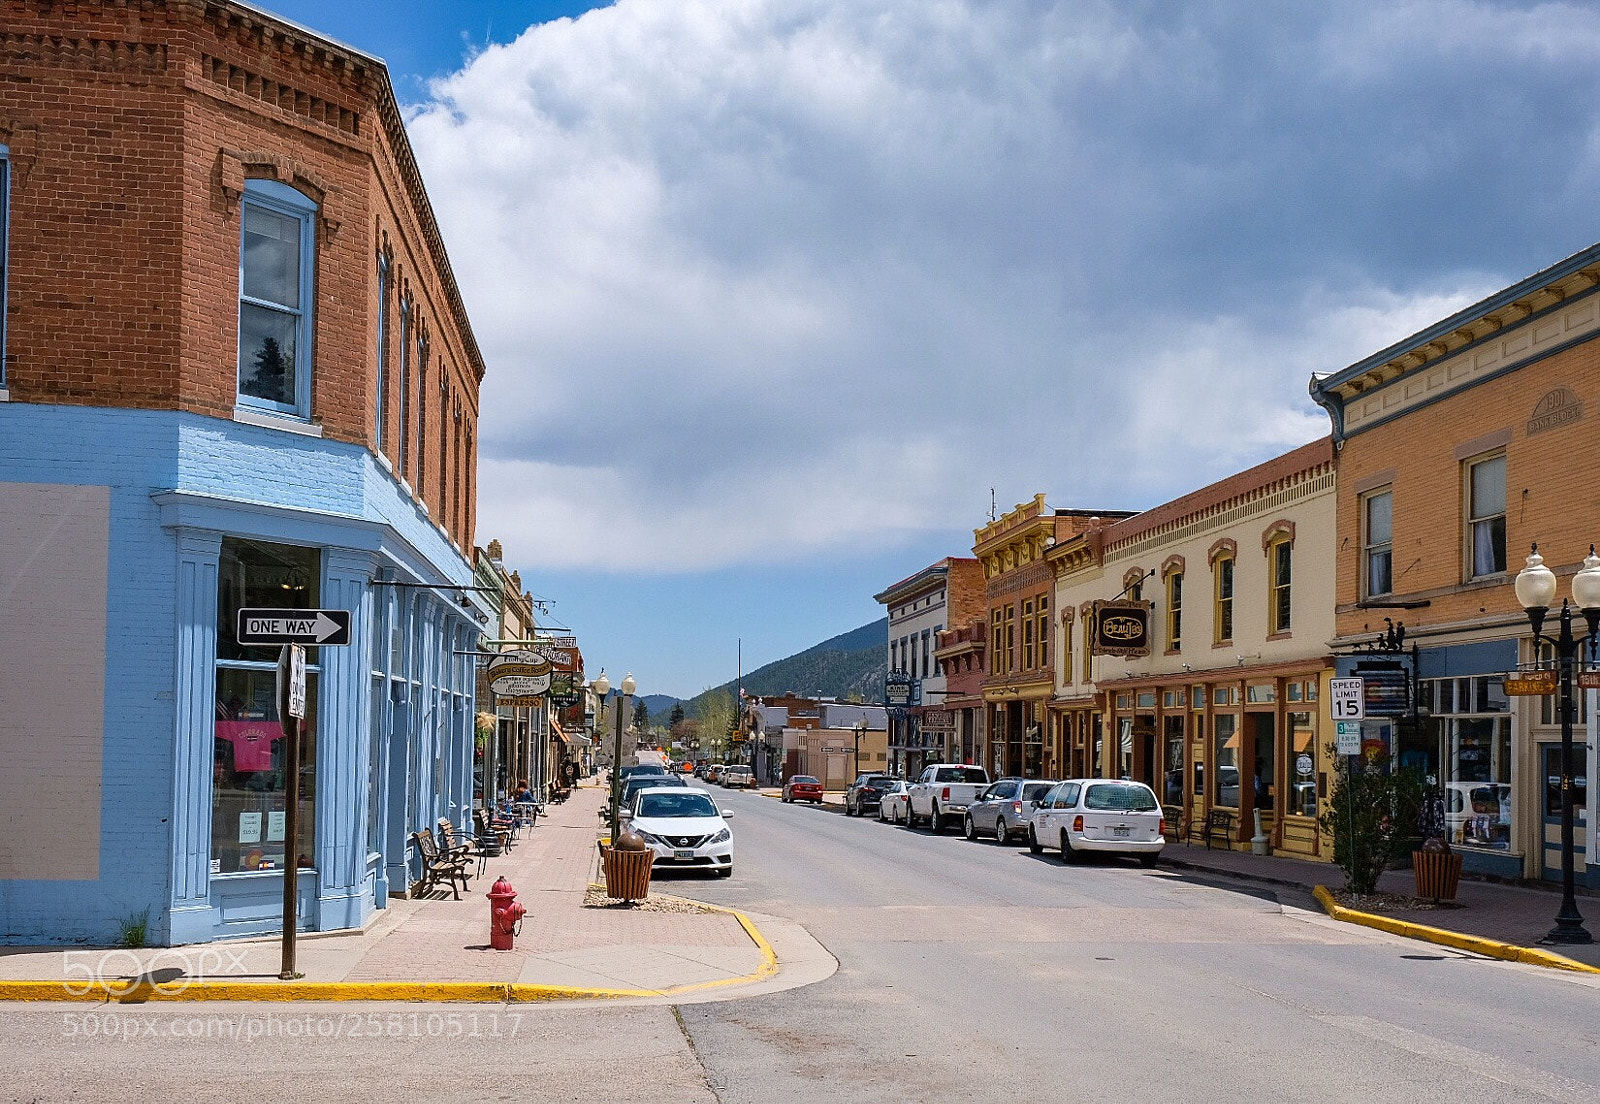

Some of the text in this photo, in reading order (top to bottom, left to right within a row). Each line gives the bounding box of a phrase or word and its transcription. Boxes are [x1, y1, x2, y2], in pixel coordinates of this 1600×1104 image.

[250, 620, 316, 634] ONE WAY
[490, 667, 511, 678] Bakery
[511, 666, 530, 674] Coffee
[1507, 681, 1544, 693] PARKING
[500, 698, 540, 707] ESPRESSO
[1336, 700, 1359, 716] 15
[238, 729, 267, 739] COLORADO
[1338, 723, 1344, 734] 3
